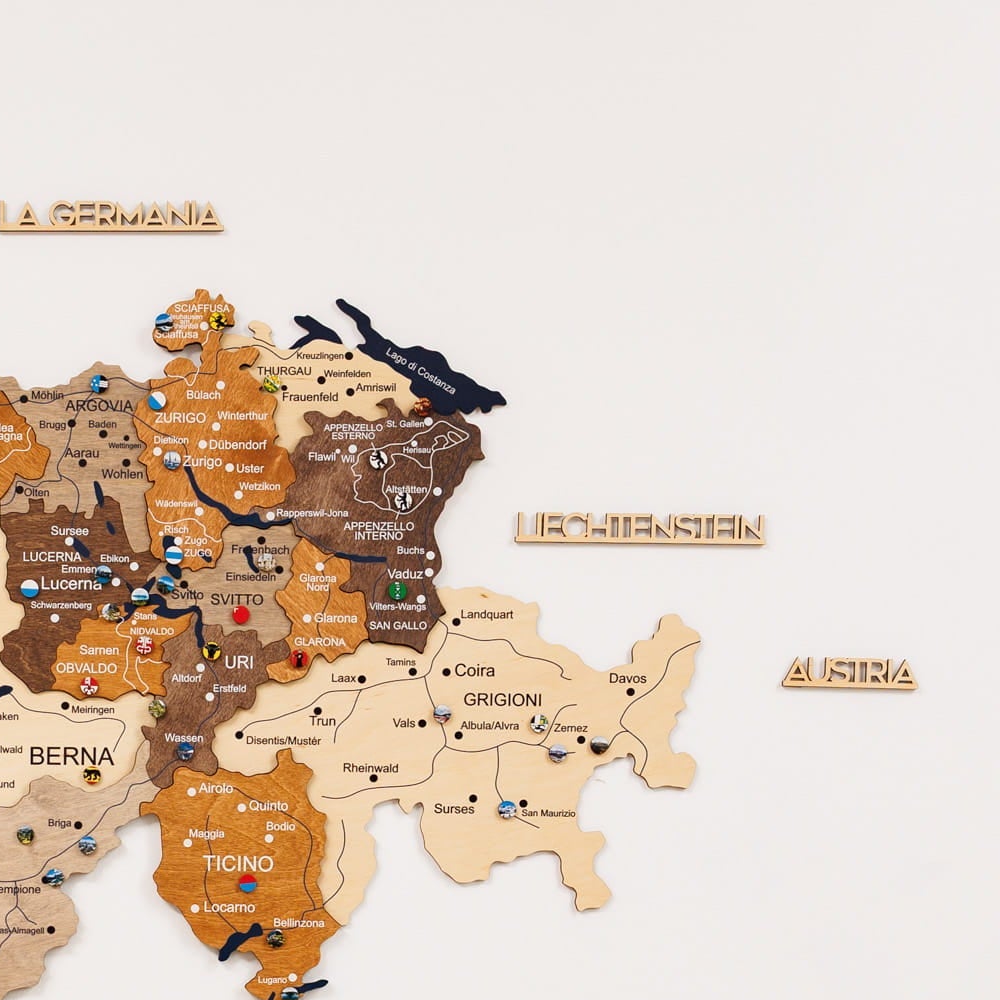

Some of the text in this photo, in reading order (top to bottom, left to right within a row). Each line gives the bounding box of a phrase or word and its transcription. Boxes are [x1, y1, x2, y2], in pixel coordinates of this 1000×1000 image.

[49, 200, 221, 227] GERMANIA
[174, 304, 230, 313] SCIAFFUSA
[297, 352, 344, 361] Kreuzlingen
[257, 366, 311, 376] THURGAU
[324, 370, 371, 378] Weinfelden
[385, 347, 456, 395] Lago di Costanza
[356, 383, 396, 392] Amriswil
[31, 390, 64, 400] Möhlin
[186, 389, 221, 400] Bülach
[282, 392, 338, 402] Frauenfeld
[65, 400, 133, 412] ARGOVIA
[155, 411, 268, 424] ZURIGO Winterthur
[39, 420, 117, 431] Brugg Baden
[324, 424, 383, 432] APPENZELLO
[332, 432, 375, 440] ESTERNO
[209, 440, 267, 450] Dübendorf
[65, 448, 100, 459] Aarau
[308, 452, 337, 462] Flawil
[183, 455, 223, 469] Zurigo
[236, 463, 264, 474] Uster
[102, 469, 143, 480] Wohlen
[239, 482, 281, 491] Wetzikon
[23, 488, 50, 497] Olten
[155, 499, 198, 508] Wädenswil
[276, 508, 349, 519] Rapperswil-Jona
[51, 526, 89, 536] Sursee
[164, 525, 189, 534] Risch
[344, 522, 414, 532] APPENZELLO
[517, 511, 766, 541] LIECHTENSTEIN
[354, 531, 403, 541] INTERNO
[184, 537, 208, 546] Zugo
[184, 549, 212, 558] ZUGO
[396, 546, 425, 555] Buchs
[22, 552, 82, 562] LUCERNA
[100, 554, 130, 563] Ebikon
[225, 572, 276, 582] Einsiedeln
[299, 574, 337, 583] Glarona
[387, 569, 423, 580] Vaduz
[41, 576, 102, 591] Lucerna
[306, 583, 329, 592] Nord
[171, 591, 204, 600] Svitto
[210, 594, 264, 606] SVITTO
[31, 601, 92, 610] Schwarzenberg
[369, 602, 427, 612] Vilters-Wangs
[314, 614, 358, 623] Glarona
[460, 610, 514, 621] Landquart
[369, 621, 428, 630] SAN GALLO
[130, 627, 174, 635] NIDVALDO
[294, 637, 346, 647] GLARONA
[225, 655, 254, 669] URI
[386, 657, 416, 667] Tamins
[56, 663, 118, 674] OBVALDO
[455, 664, 495, 677] Coira
[784, 657, 917, 687] AUSTRIA
[171, 674, 202, 683] Altdorf
[331, 674, 357, 683] Laax
[609, 673, 647, 685] Davos
[213, 684, 247, 694] Erstfeld
[463, 693, 543, 707] GRIGIONI
[71, 705, 115, 716] Meiringen
[309, 716, 336, 727] Trun
[392, 718, 416, 729] Vals
[460, 721, 520, 731] Albula/Alvra
[164, 733, 204, 743] Wassen
[246, 736, 321, 746] Disentis/Mustér
[30, 747, 115, 766] BERNA
[343, 763, 399, 774] Rheinwald
[198, 784, 234, 794] Airolo
[249, 801, 289, 812] Quinto
[434, 804, 475, 815] Surses
[521, 809, 576, 818] San Maurizio
[48, 818, 72, 829] Briga
[266, 822, 296, 832] Bodio
[188, 829, 225, 840] Maggia
[203, 855, 274, 873] TICINO
[204, 901, 256, 913] Locarno
[273, 918, 325, 928] Bellinzona
